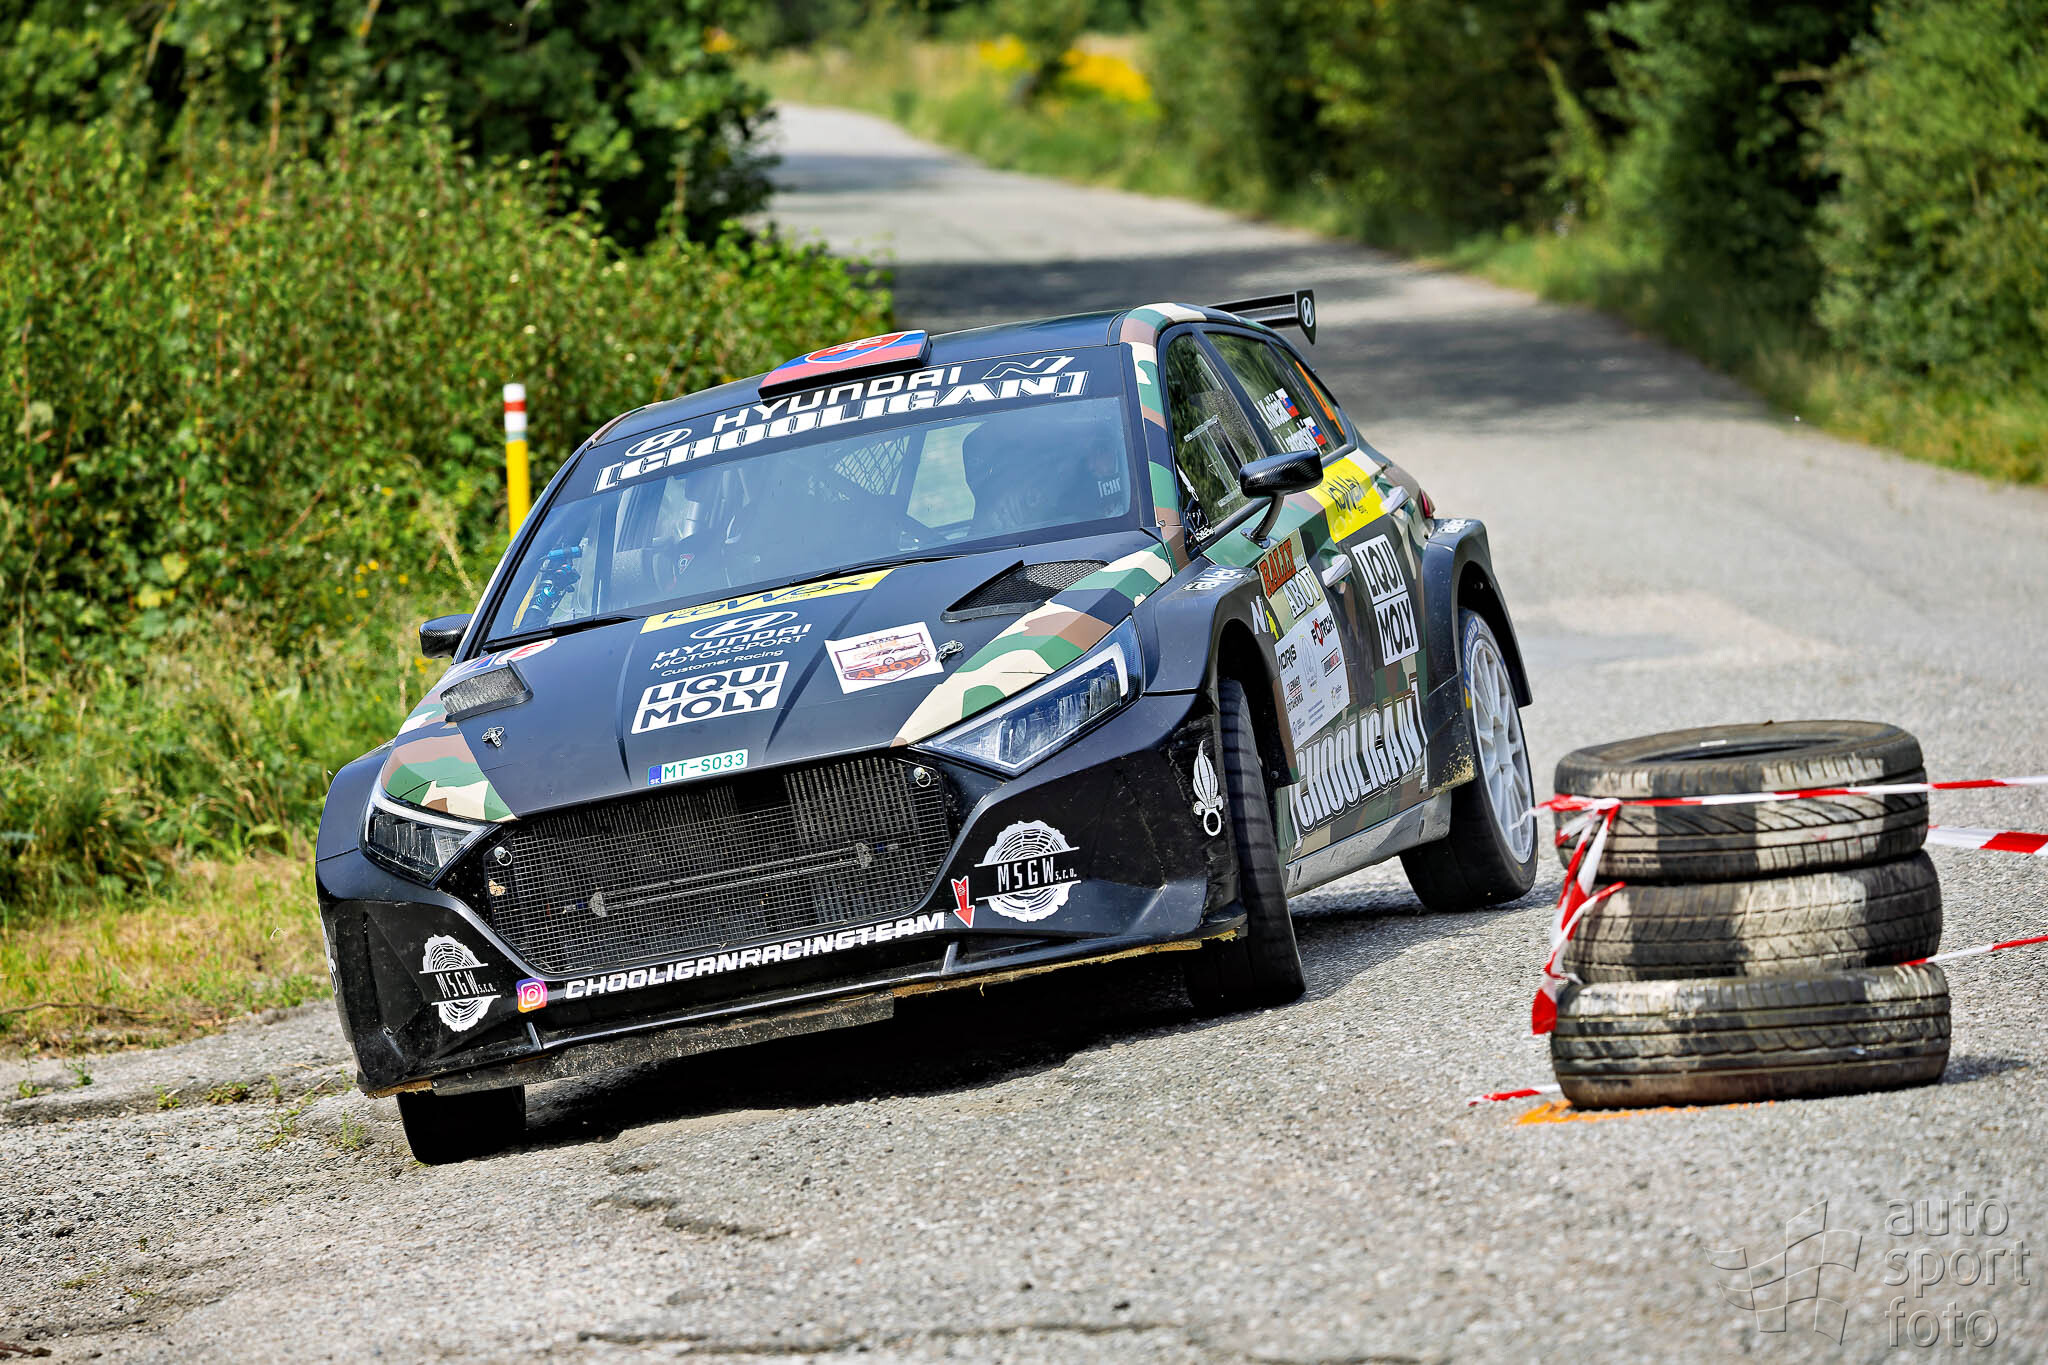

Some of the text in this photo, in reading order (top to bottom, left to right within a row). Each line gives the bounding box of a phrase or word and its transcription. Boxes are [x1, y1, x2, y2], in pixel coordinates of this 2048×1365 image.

[711, 365, 962, 436] HYUNDAI
[1260, 538, 1296, 599] RALLY
[1355, 539, 1404, 598] LIQUI
[1282, 566, 1321, 619] ABOV
[654, 623, 813, 661] HYUNDAI
[1377, 599, 1415, 660] MOLY
[649, 635, 807, 671] MOTORSPORT
[660, 649, 784, 677] Customer Racing
[856, 657, 923, 680] ABOV
[648, 664, 777, 705] LIQUI
[640, 687, 769, 730] MOLY
[664, 752, 744, 779] MT-S033
[997, 856, 1054, 892] MSGW
[564, 912, 945, 999] CHOOLIGANRACINGTEAM
[435, 970, 479, 999] MSGW
